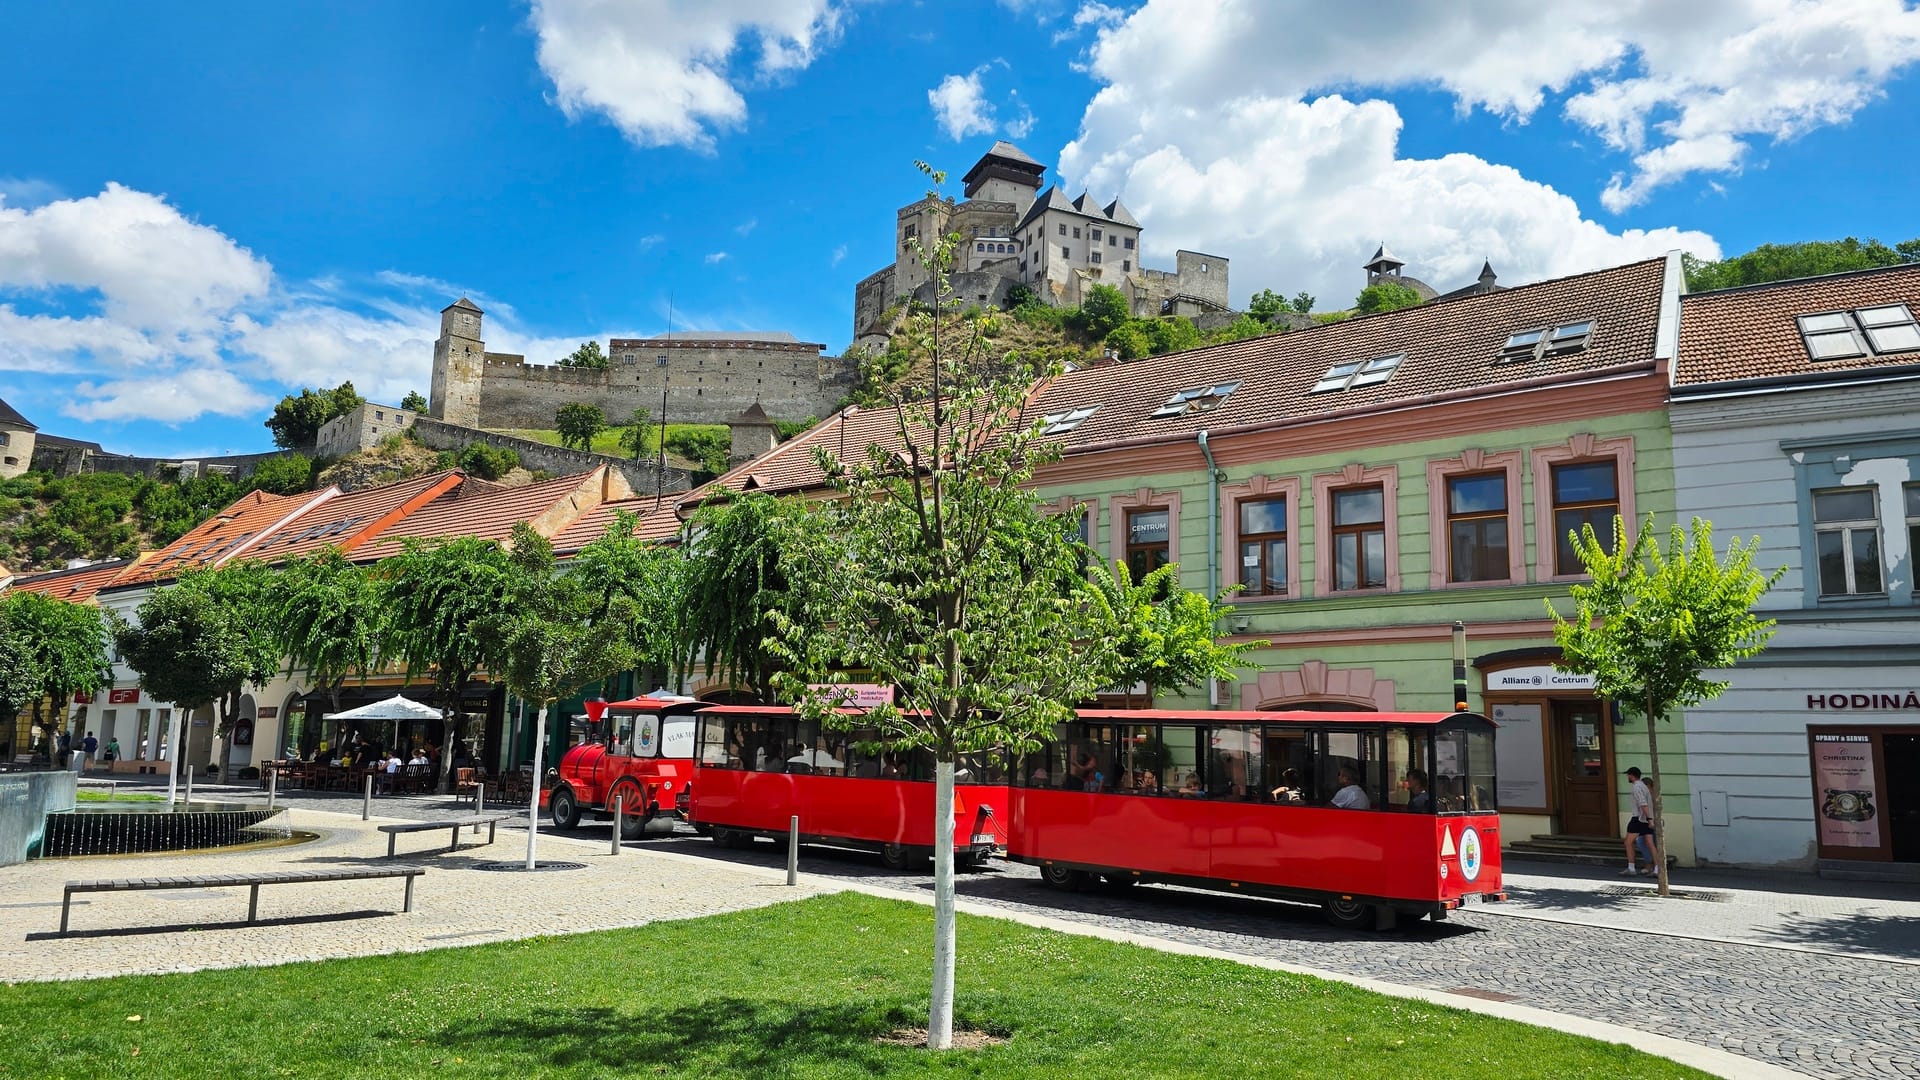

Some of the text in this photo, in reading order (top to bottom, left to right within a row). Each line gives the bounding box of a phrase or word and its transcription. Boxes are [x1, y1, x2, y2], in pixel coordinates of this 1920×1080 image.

[1131, 522, 1167, 532] CENTRUM
[1502, 676, 1589, 685] Allianz Centrum
